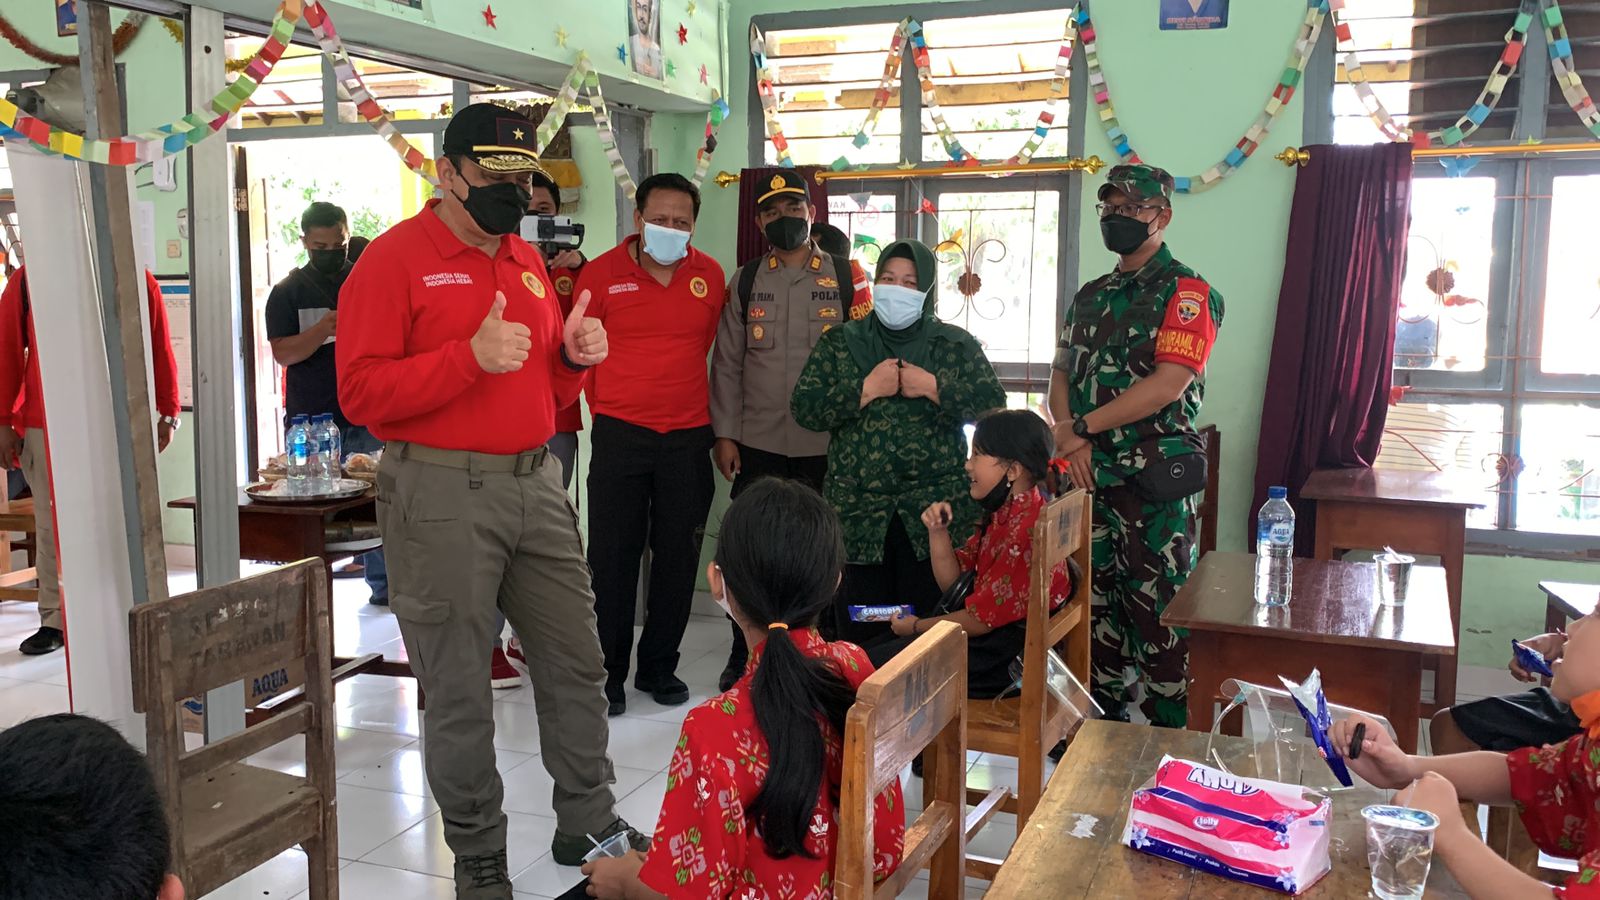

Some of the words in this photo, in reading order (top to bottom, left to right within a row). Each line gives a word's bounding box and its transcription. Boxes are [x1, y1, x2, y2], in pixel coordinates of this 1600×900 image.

[422, 273, 454, 281] INDONESIA
[425, 279, 455, 287] INDONESIA
[811, 291, 840, 300] POLR
[252, 668, 289, 697] AQUA
